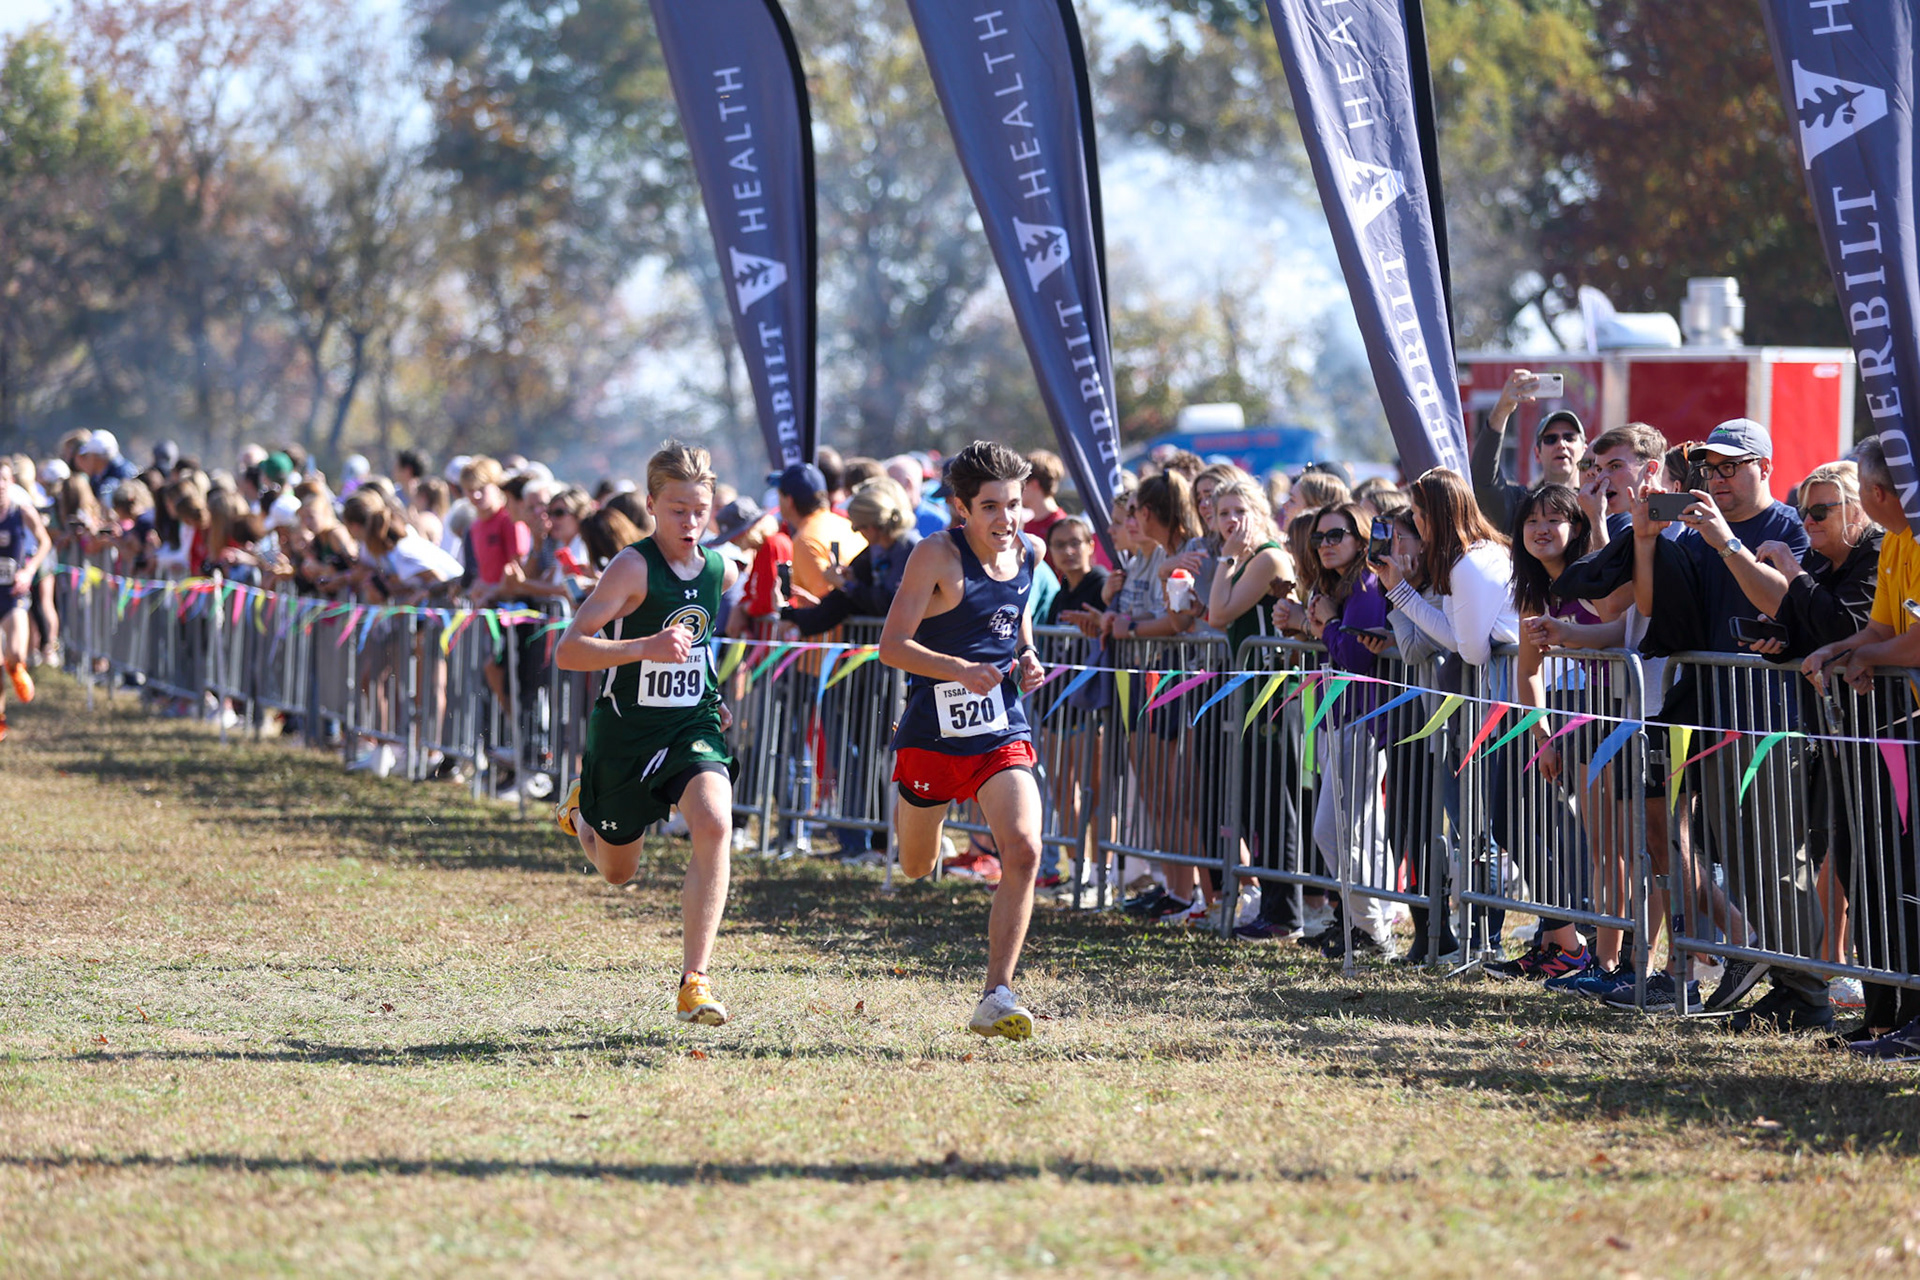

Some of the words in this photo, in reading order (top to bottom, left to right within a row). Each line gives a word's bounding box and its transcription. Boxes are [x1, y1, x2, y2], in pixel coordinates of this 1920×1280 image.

[973, 9, 1051, 200] HEALTH
[713, 66, 767, 234] HEALTH
[644, 669, 701, 699] 1039
[943, 688, 967, 698] TSSAA
[949, 696, 996, 730] 520
